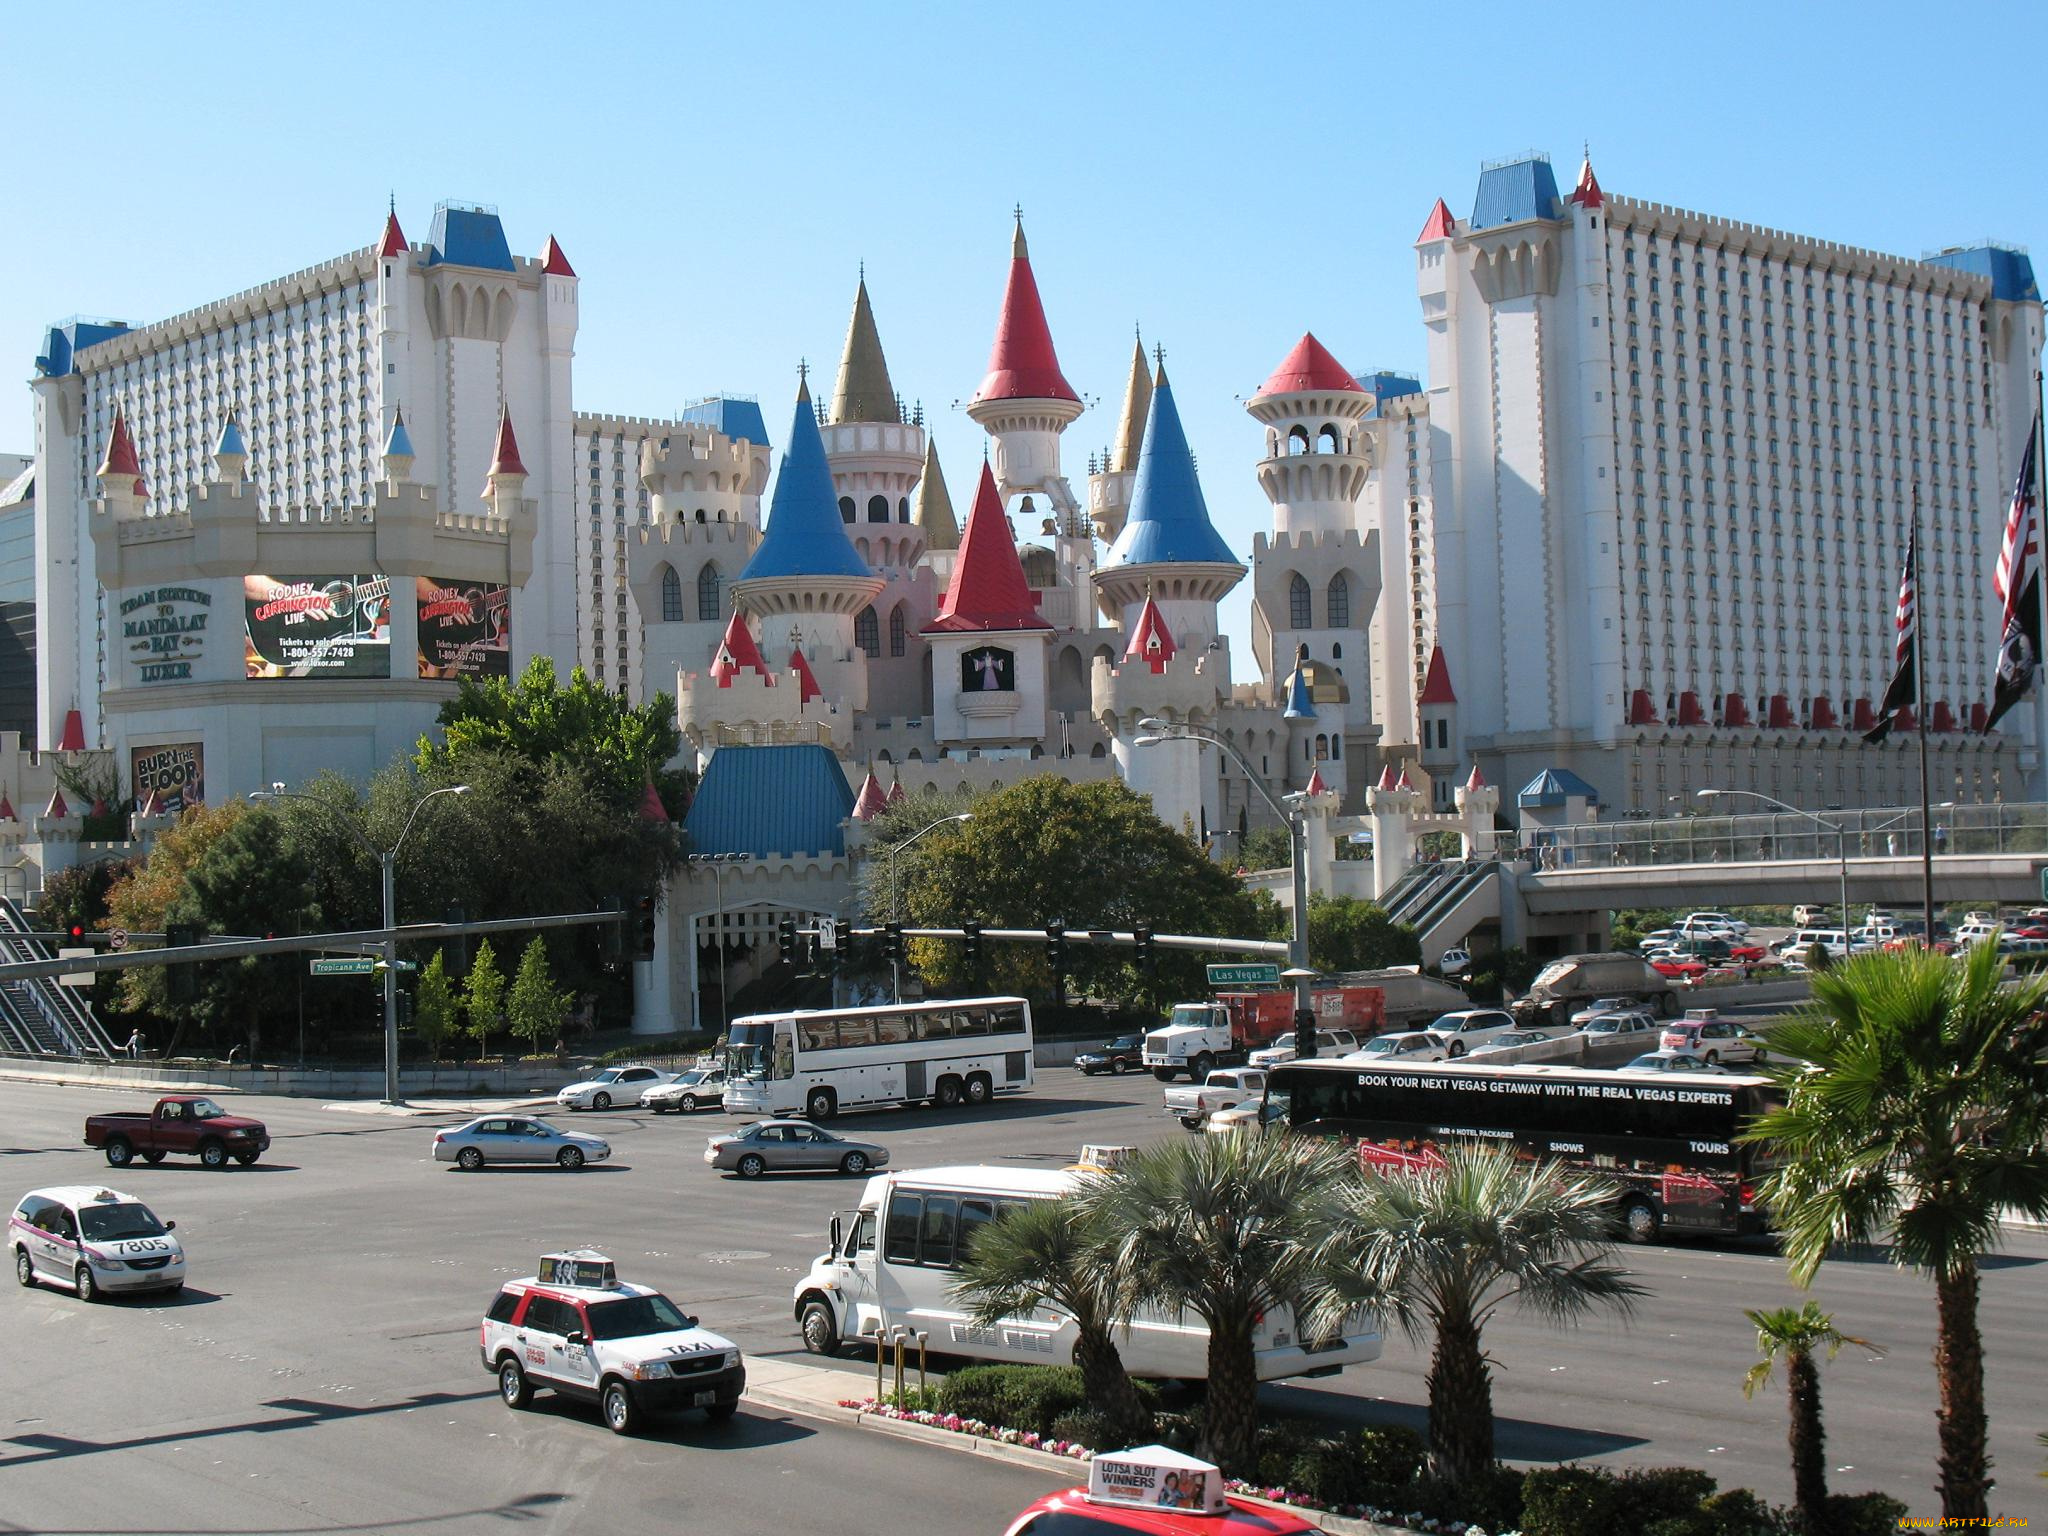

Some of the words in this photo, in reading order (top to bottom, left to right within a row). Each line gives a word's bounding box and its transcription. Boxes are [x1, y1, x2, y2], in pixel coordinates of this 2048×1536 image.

[268, 582, 314, 601] RODNEY
[428, 587, 459, 603] RODNEY
[120, 591, 156, 616] TRAM
[157, 588, 211, 607] STATION
[255, 597, 331, 620] CARRINGTON
[157, 604, 174, 617] TO
[124, 614, 208, 637] MANDALAY
[284, 612, 305, 625] LIVE
[439, 615, 454, 627] LIVE
[150, 635, 180, 653] BAY
[279, 638, 303, 646] Tickets
[282, 647, 354, 658] 1-800-557-7428
[438, 650, 486, 662] 1-800-557-7428
[291, 659, 345, 667] www.luxor.com
[141, 662, 192, 681] LUXOR
[138, 749, 178, 776] BURN
[178, 749, 194, 761] THE
[139, 761, 196, 792] FLOOR
[316, 964, 353, 972] Tropicana
[356, 962, 370, 970] Ave
[1216, 970, 1233, 980] Las
[1235, 969, 1262, 981] Vegas
[1358, 1075, 1388, 1087] BOOK
[1390, 1076, 1419, 1088] YOUR
[1421, 1078, 1449, 1090] NEXT
[1451, 1079, 1487, 1092] VEGAS
[1490, 1082, 1542, 1095] GETAWAY
[1545, 1084, 1575, 1096] WITH
[1577, 1085, 1600, 1097] THE
[1602, 1087, 1633, 1099] REAL
[1635, 1088, 1676, 1102] VEGAS
[1678, 1091, 1732, 1105] EXPERTS
[1438, 1127, 1450, 1135] AIR
[1456, 1128, 1478, 1137] HOTEL
[1479, 1129, 1514, 1139] PACKAGES
[1550, 1142, 1584, 1153] SHOWS
[1690, 1141, 1729, 1154] TOURS
[112, 1239, 169, 1255] 7805
[662, 1342, 714, 1354] TAXI
[1102, 1462, 1130, 1474] LOTSA
[1133, 1466, 1157, 1477] SLOT
[1102, 1473, 1156, 1488] WINNERS
